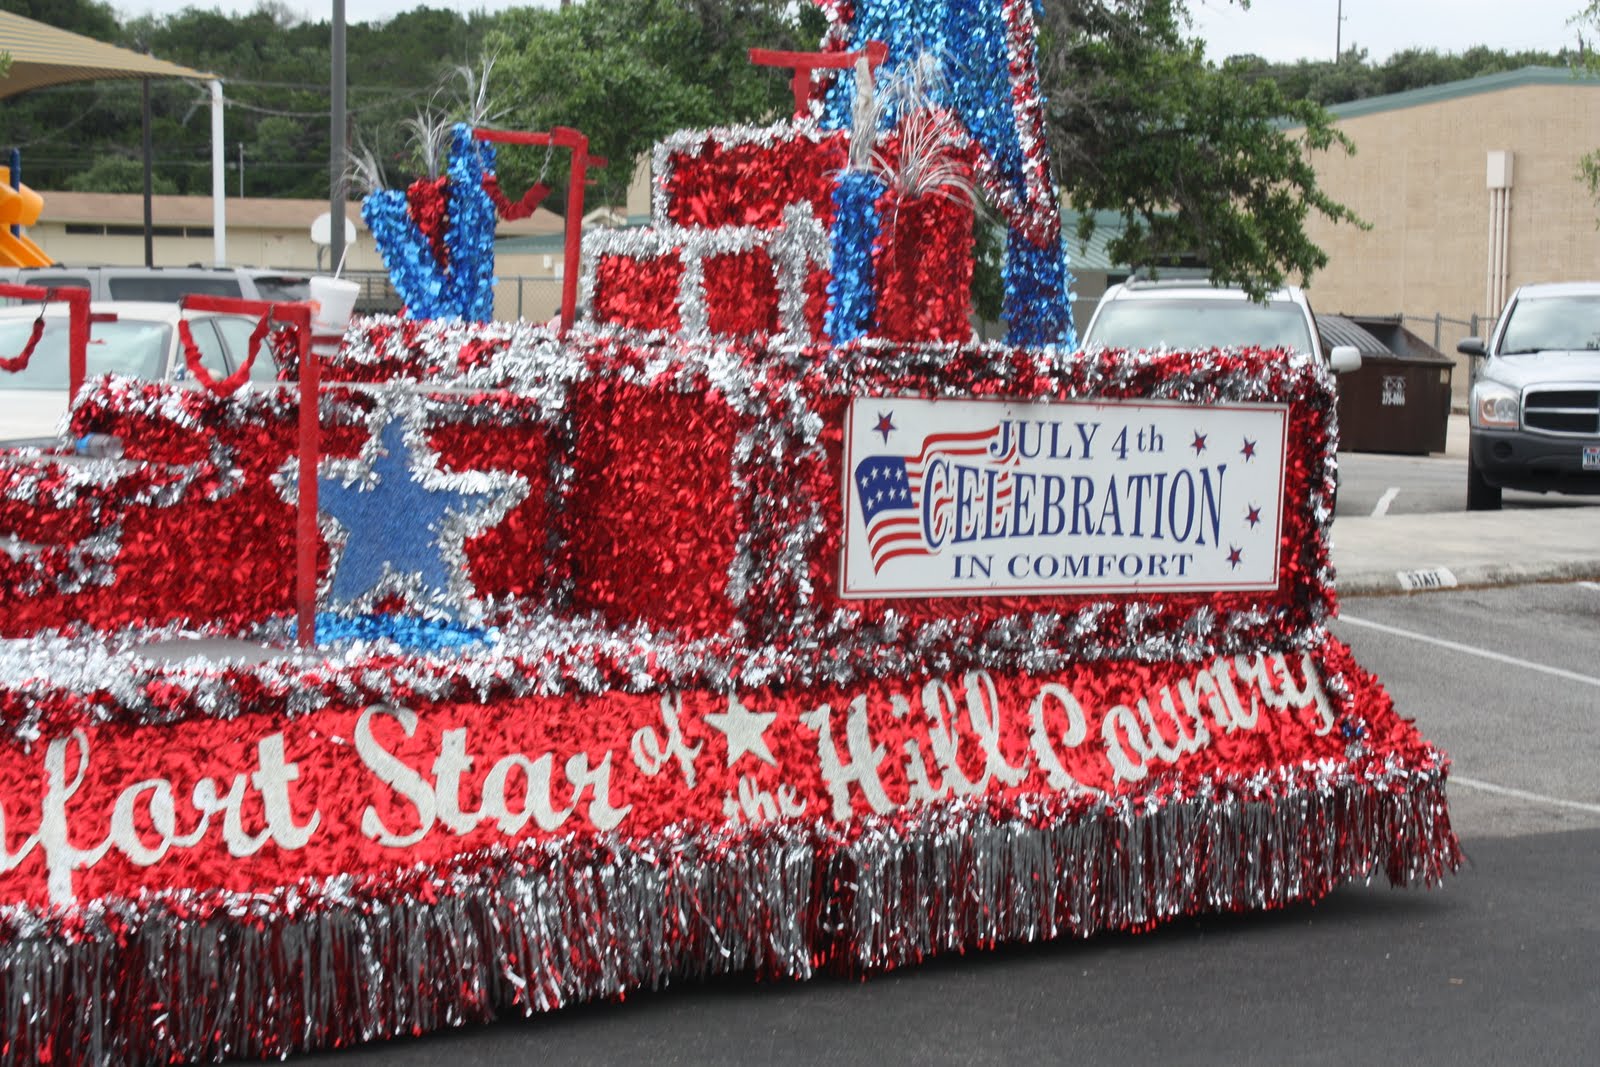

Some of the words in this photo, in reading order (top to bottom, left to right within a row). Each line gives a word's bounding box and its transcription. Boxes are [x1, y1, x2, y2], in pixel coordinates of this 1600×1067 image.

[989, 420, 1101, 461] JULY
[1111, 424, 1165, 460] 4th
[921, 458, 1228, 549] CELEBRATION
[952, 554, 993, 579] IN
[1006, 553, 1194, 579] COMFORT
[1407, 571, 1442, 588] STAFF
[0, 728, 320, 904] fort
[353, 702, 632, 847] Star
[631, 690, 702, 790] of
[722, 774, 807, 826] the
[799, 670, 1029, 823] Hill
[1028, 651, 1334, 794] Country
